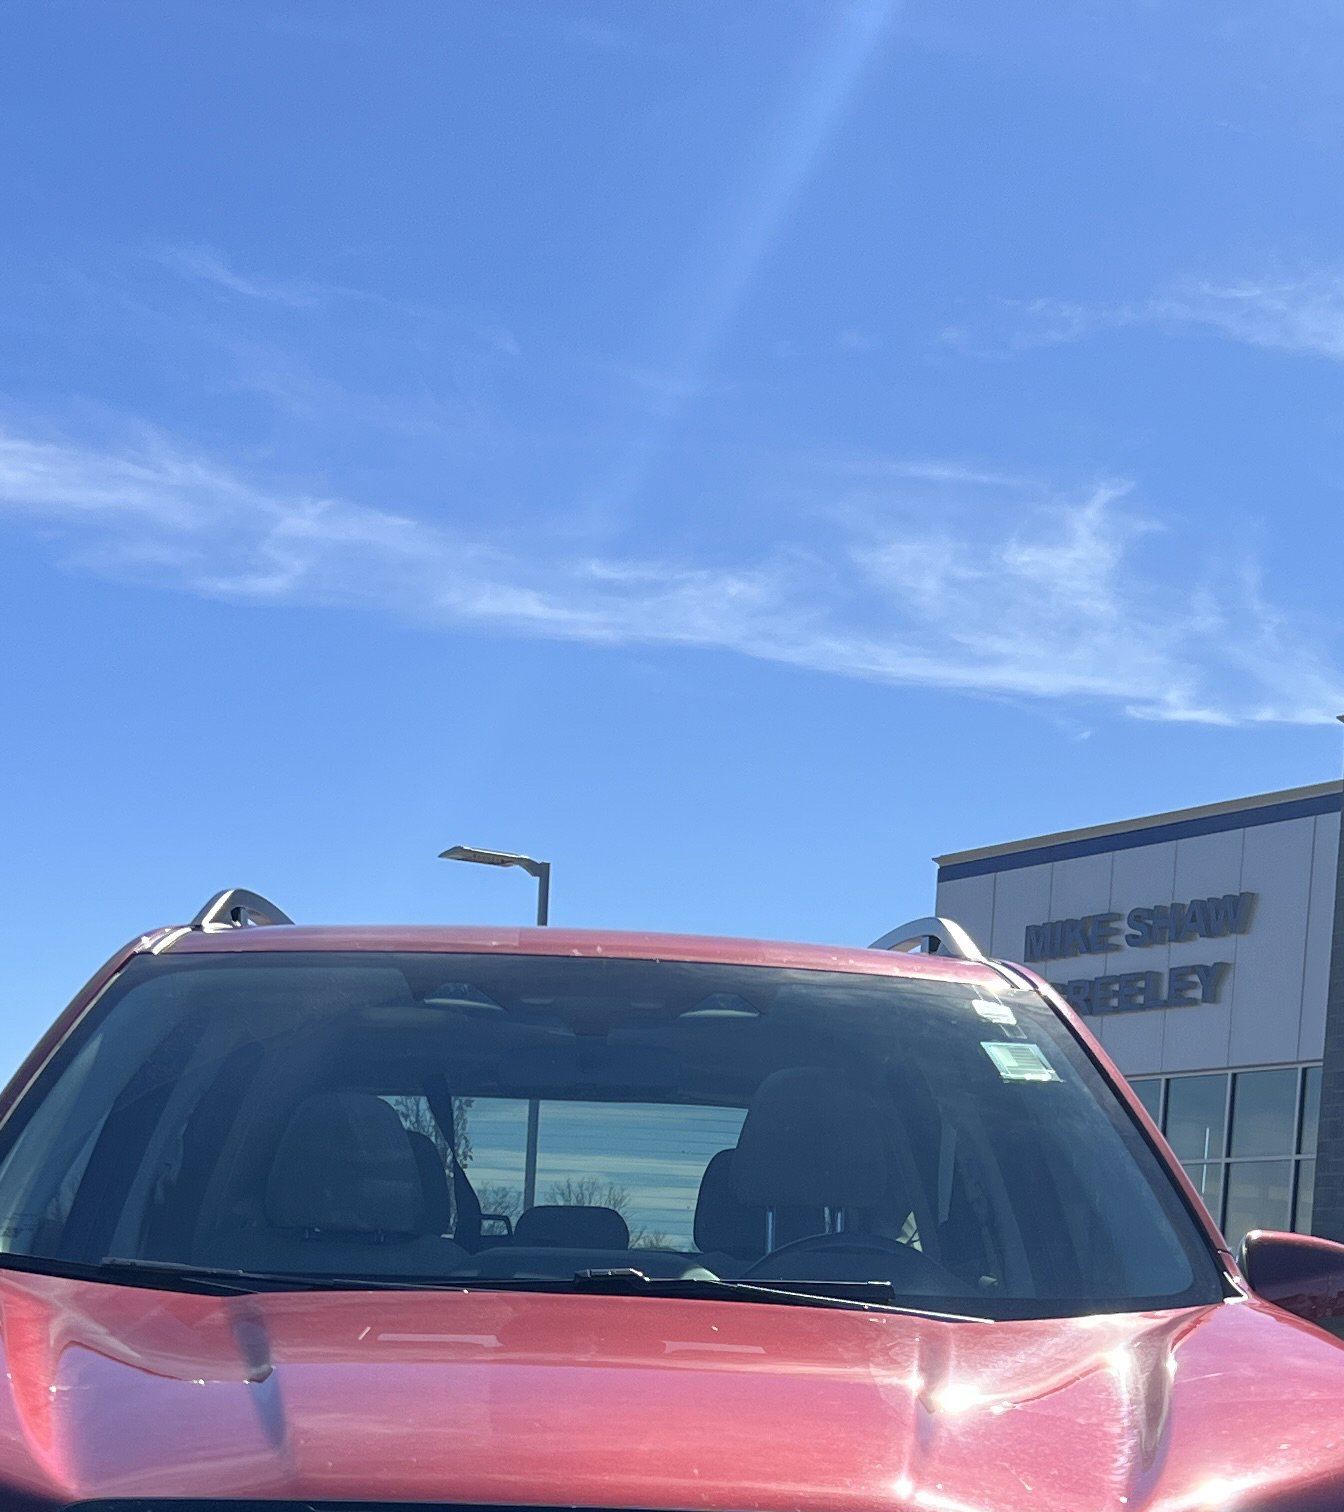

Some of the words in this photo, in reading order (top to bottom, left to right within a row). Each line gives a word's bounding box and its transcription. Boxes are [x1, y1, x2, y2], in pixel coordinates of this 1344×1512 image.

[1024, 911, 1123, 962] MIKE
[1125, 891, 1257, 948] SHAW
[1050, 962, 1233, 1016] REELEY
